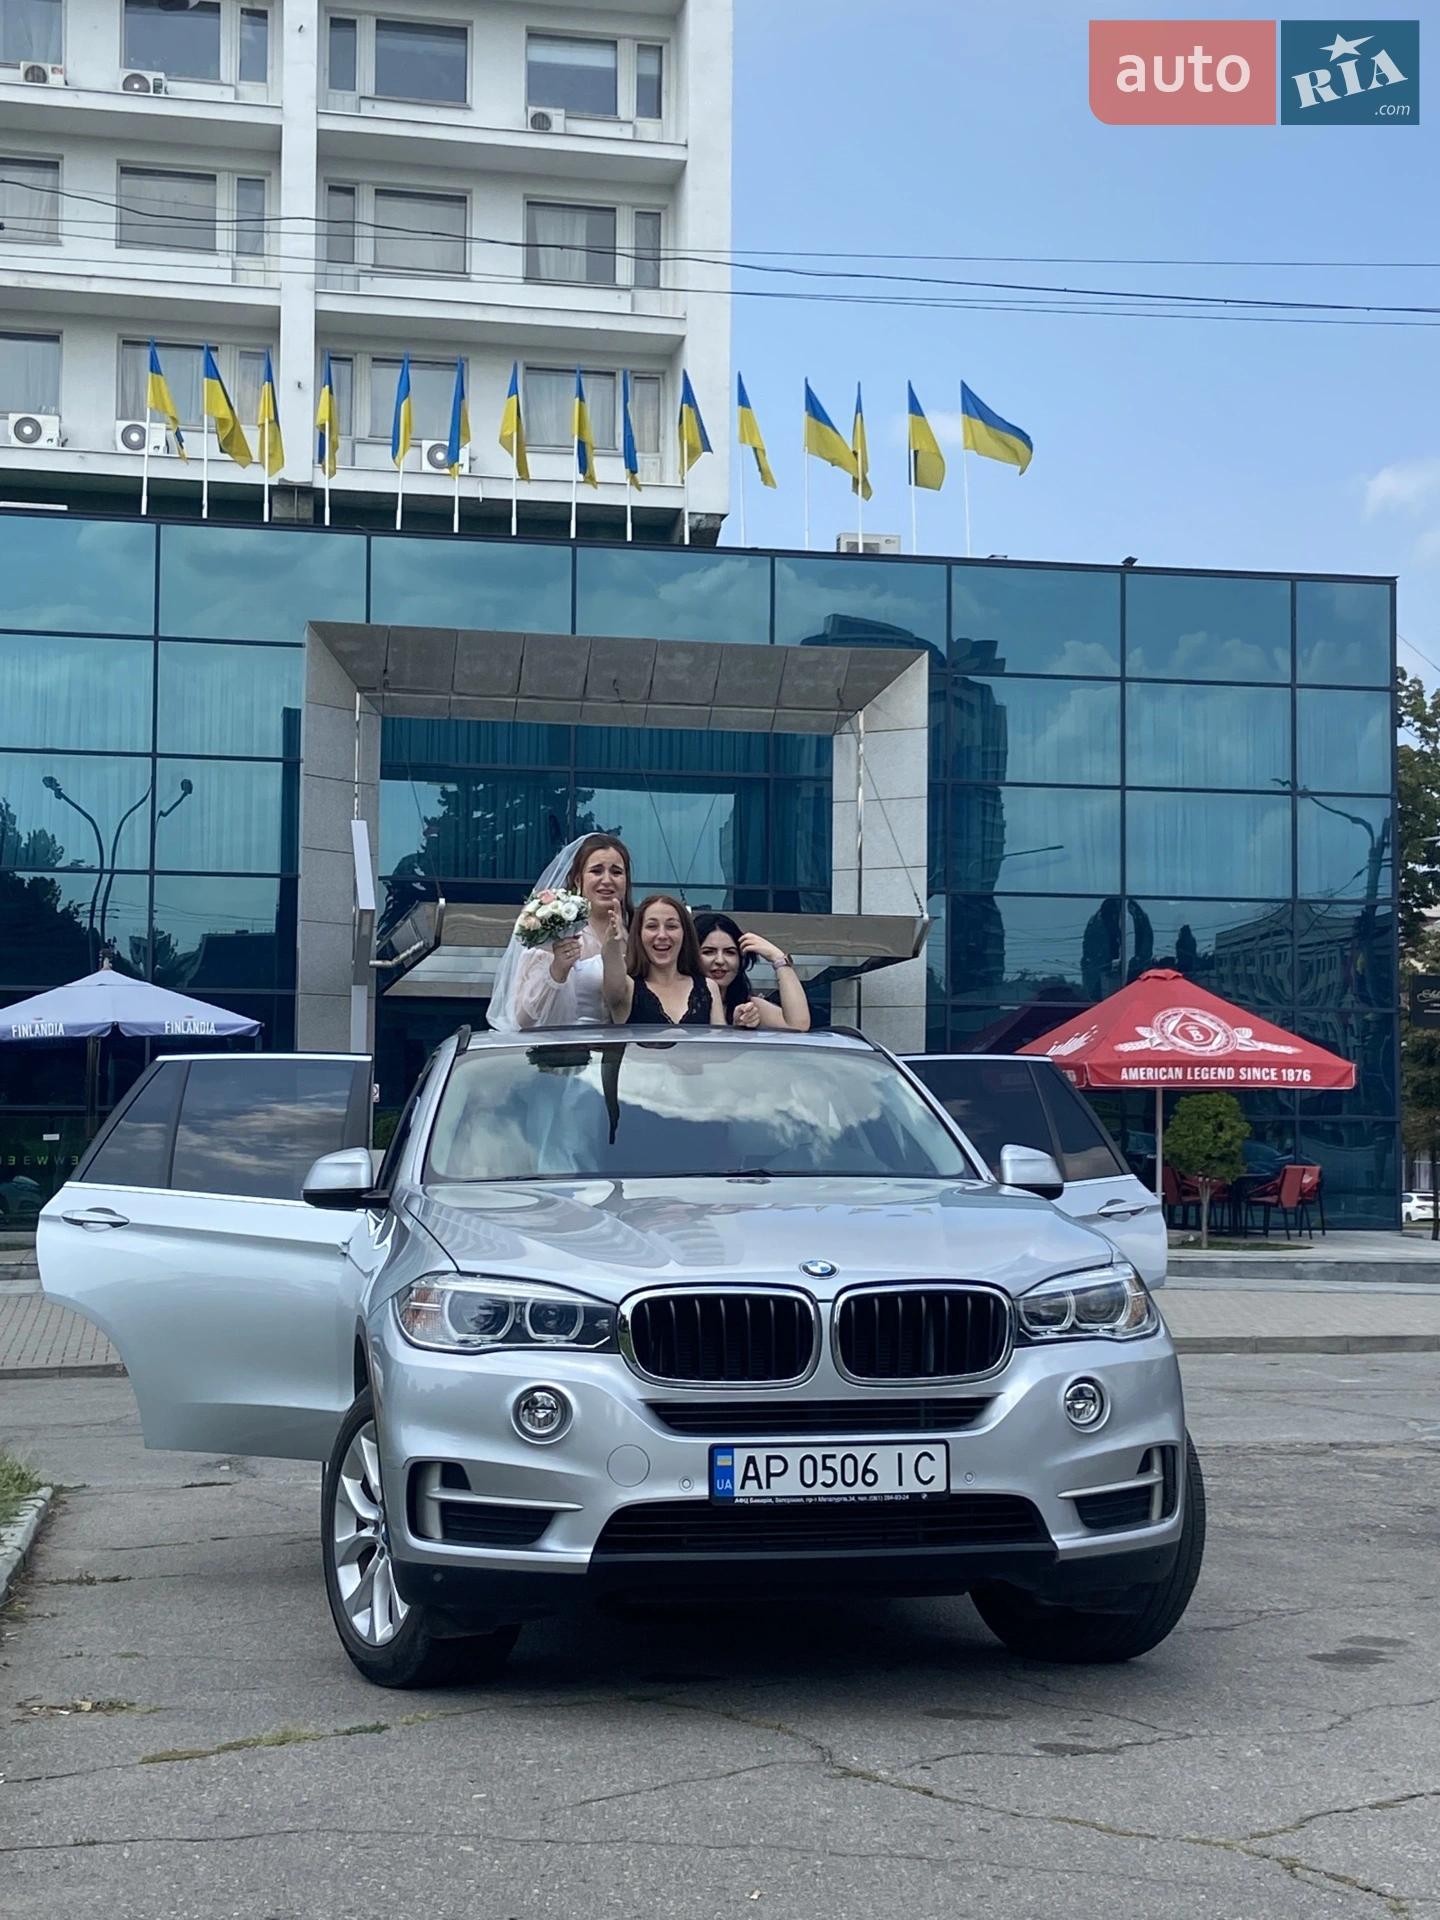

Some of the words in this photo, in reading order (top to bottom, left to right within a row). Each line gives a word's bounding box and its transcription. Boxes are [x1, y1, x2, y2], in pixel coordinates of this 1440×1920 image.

[11, 1022, 66, 1038] FINLANDIA
[164, 1020, 217, 1035] FINLANDIA
[1120, 1067, 1183, 1081] AMERICAN
[1187, 1067, 1235, 1081] LEGEND
[1239, 1068, 1279, 1082] SINCE
[1281, 1069, 1312, 1082] 1876
[739, 1454, 789, 1490] AP
[799, 1453, 879, 1489] 0506
[716, 1480, 733, 1490] UA
